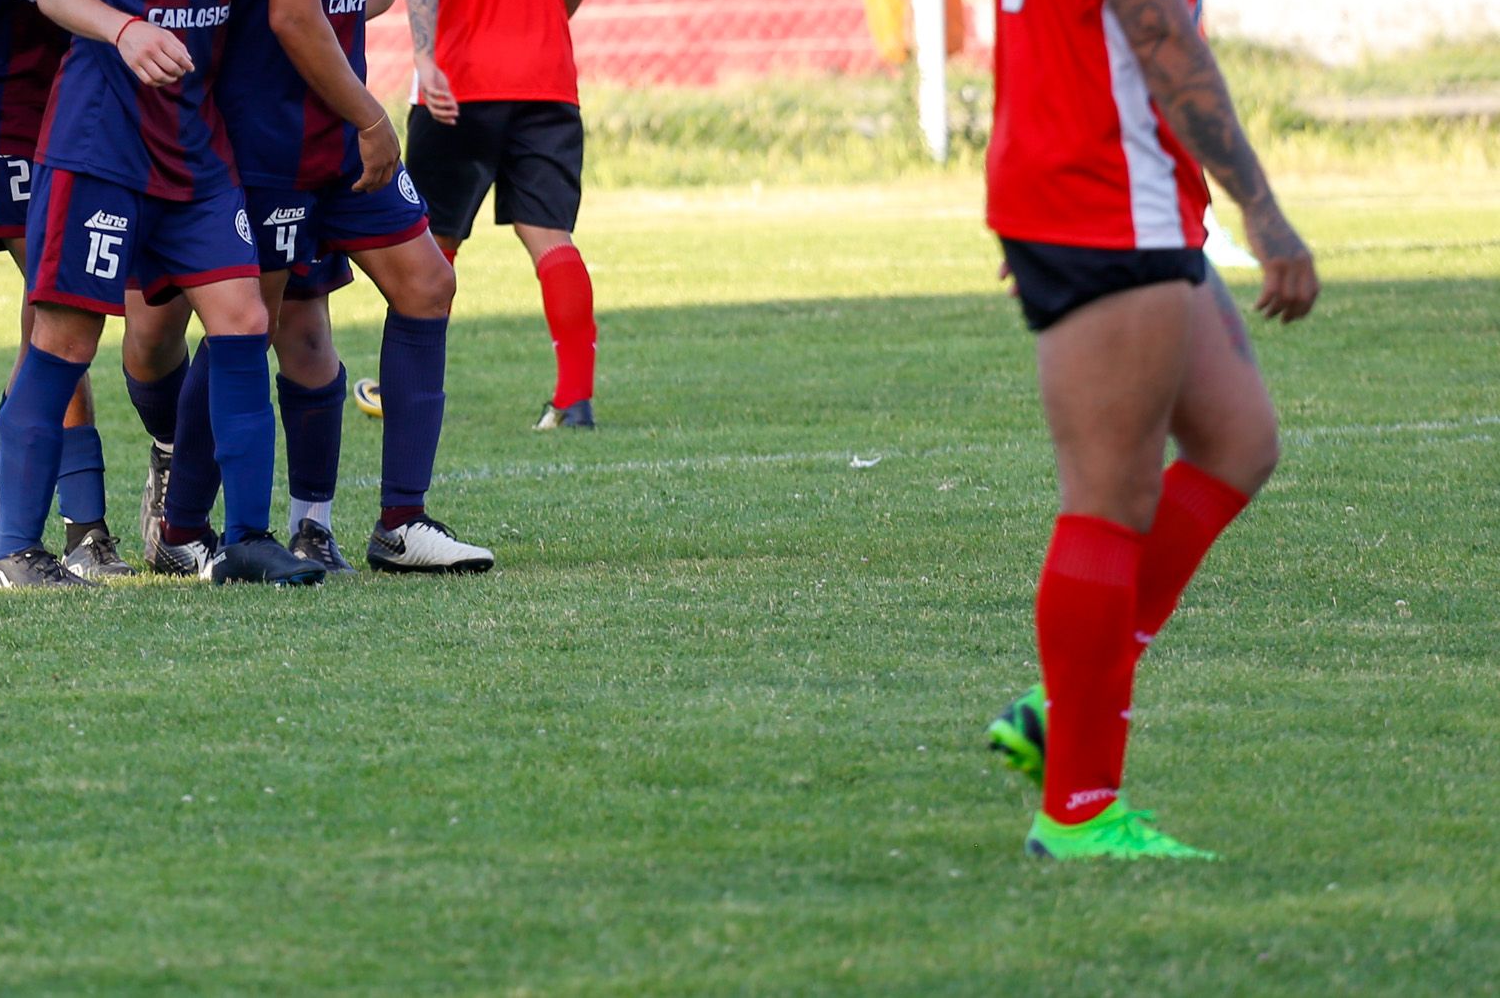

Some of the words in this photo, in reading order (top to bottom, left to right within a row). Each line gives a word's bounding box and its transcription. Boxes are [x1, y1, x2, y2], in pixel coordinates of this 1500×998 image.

[7, 159, 31, 202] 2
[85, 231, 123, 280] 15
[275, 224, 298, 263] 4
